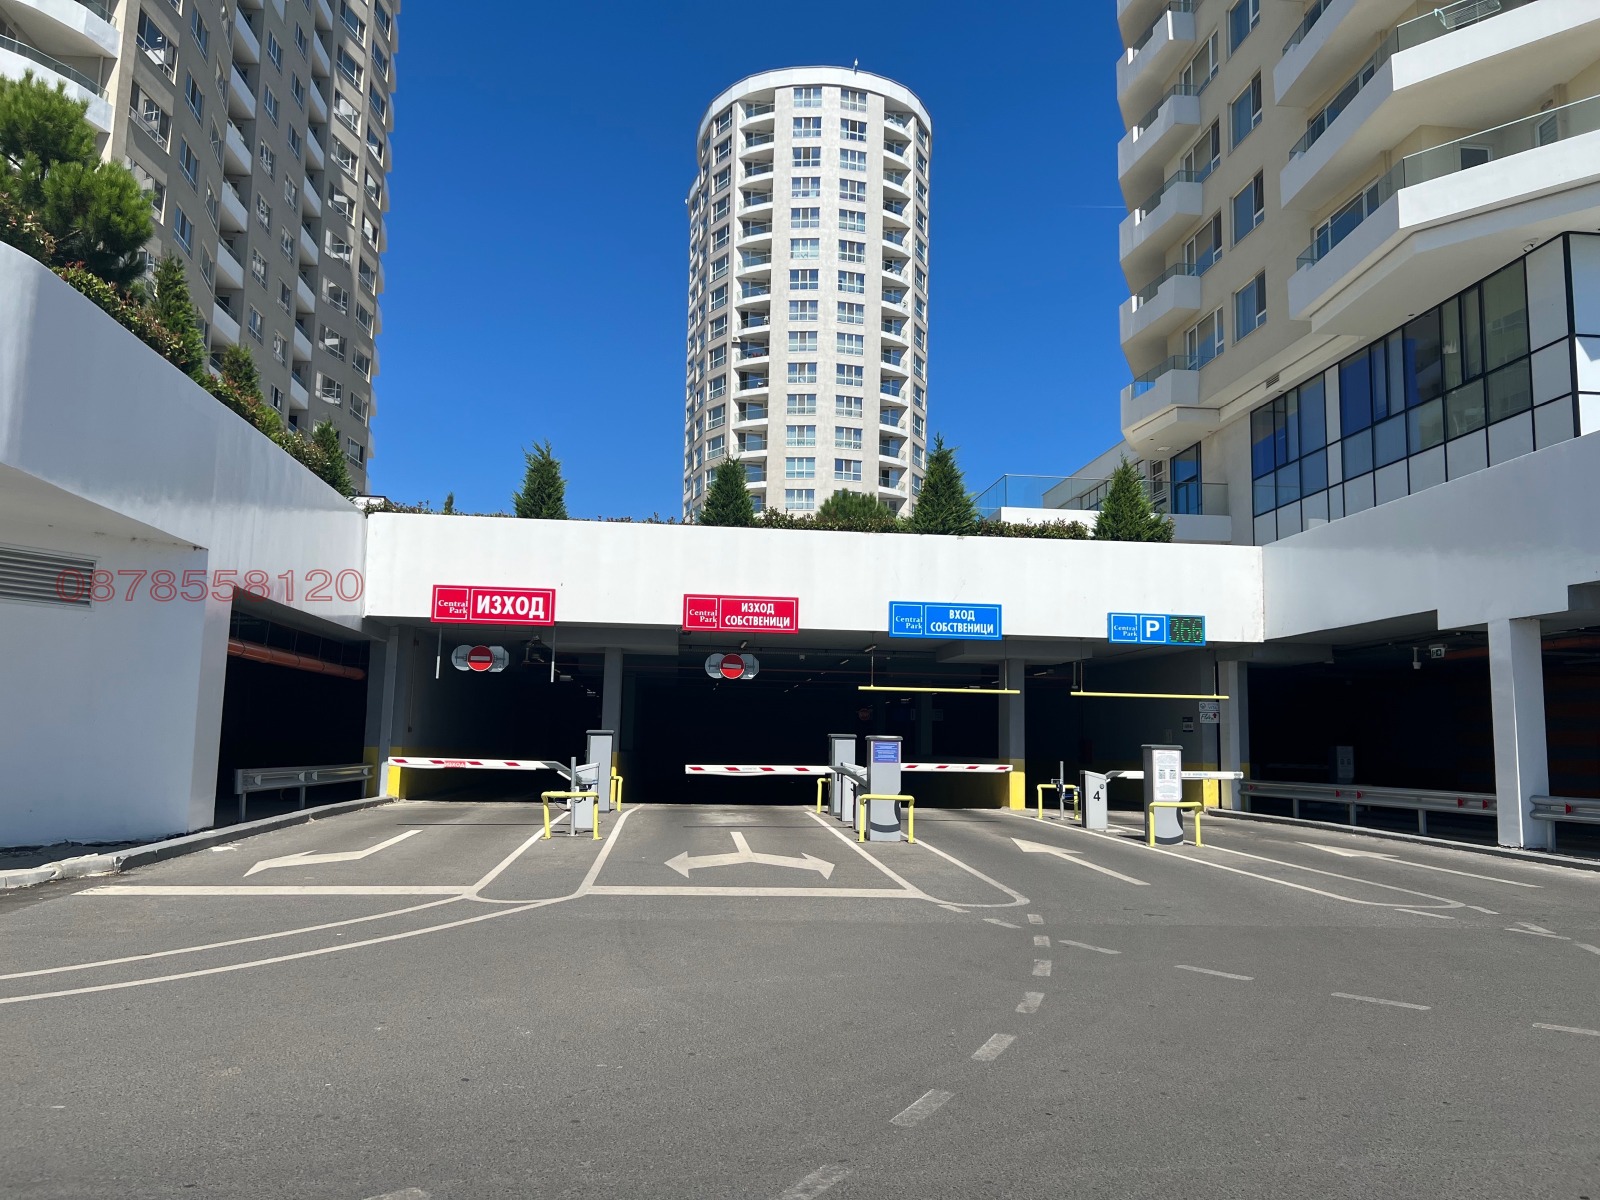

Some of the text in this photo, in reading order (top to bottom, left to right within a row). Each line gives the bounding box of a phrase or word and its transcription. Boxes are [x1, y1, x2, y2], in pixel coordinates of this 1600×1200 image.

[449, 606, 468, 614] Park
[476, 594, 545, 619] ИЗХОД
[741, 603, 774, 615] ИЗХОД
[949, 609, 975, 621] ВХОД
[725, 615, 790, 628] СОБСТВЕНИЦИ
[930, 622, 994, 635] СОБСТВЕНИЦИ
[1146, 620, 1160, 637] P
[1093, 790, 1101, 802] 4
